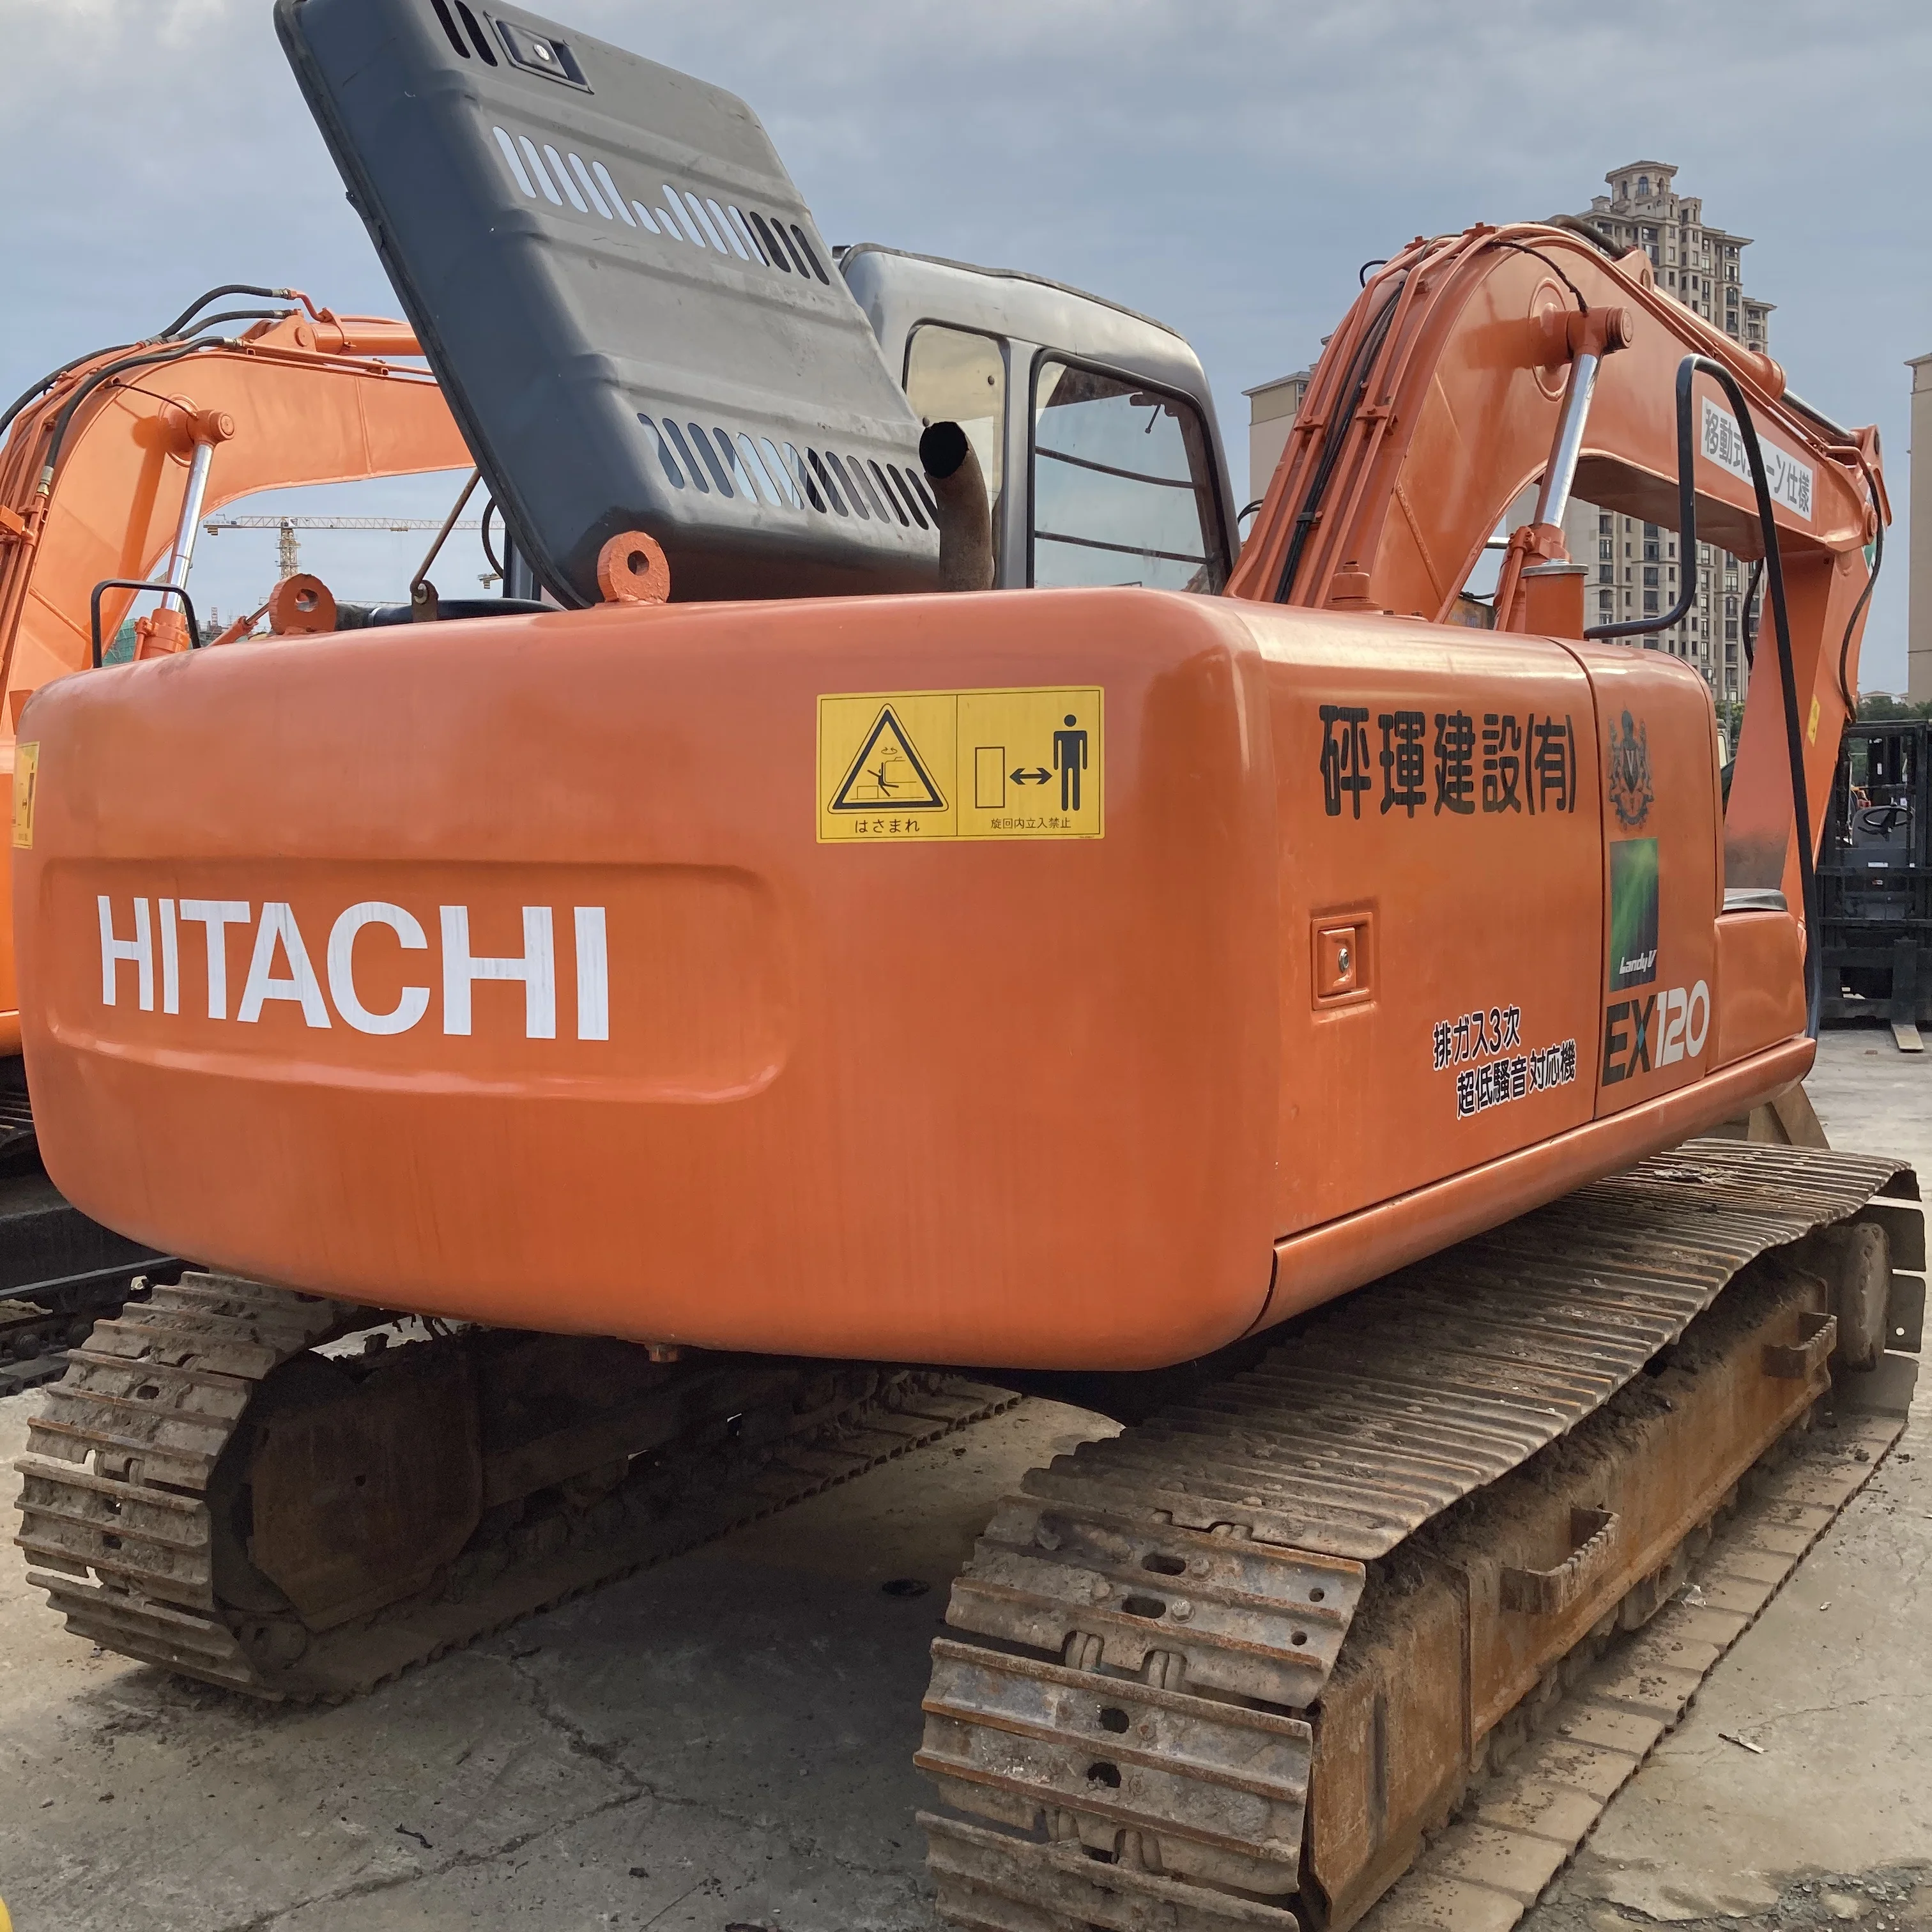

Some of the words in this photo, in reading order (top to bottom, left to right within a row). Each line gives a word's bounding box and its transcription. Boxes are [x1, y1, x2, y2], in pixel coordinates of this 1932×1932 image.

[855, 818, 920, 834] はさまれ
[991, 817, 1071, 829] 旋回内立入禁止
[97, 895, 610, 1041] HITACHI
[1433, 1004, 1521, 1070] 排ガス3次
[1602, 979, 1710, 1087] EX120
